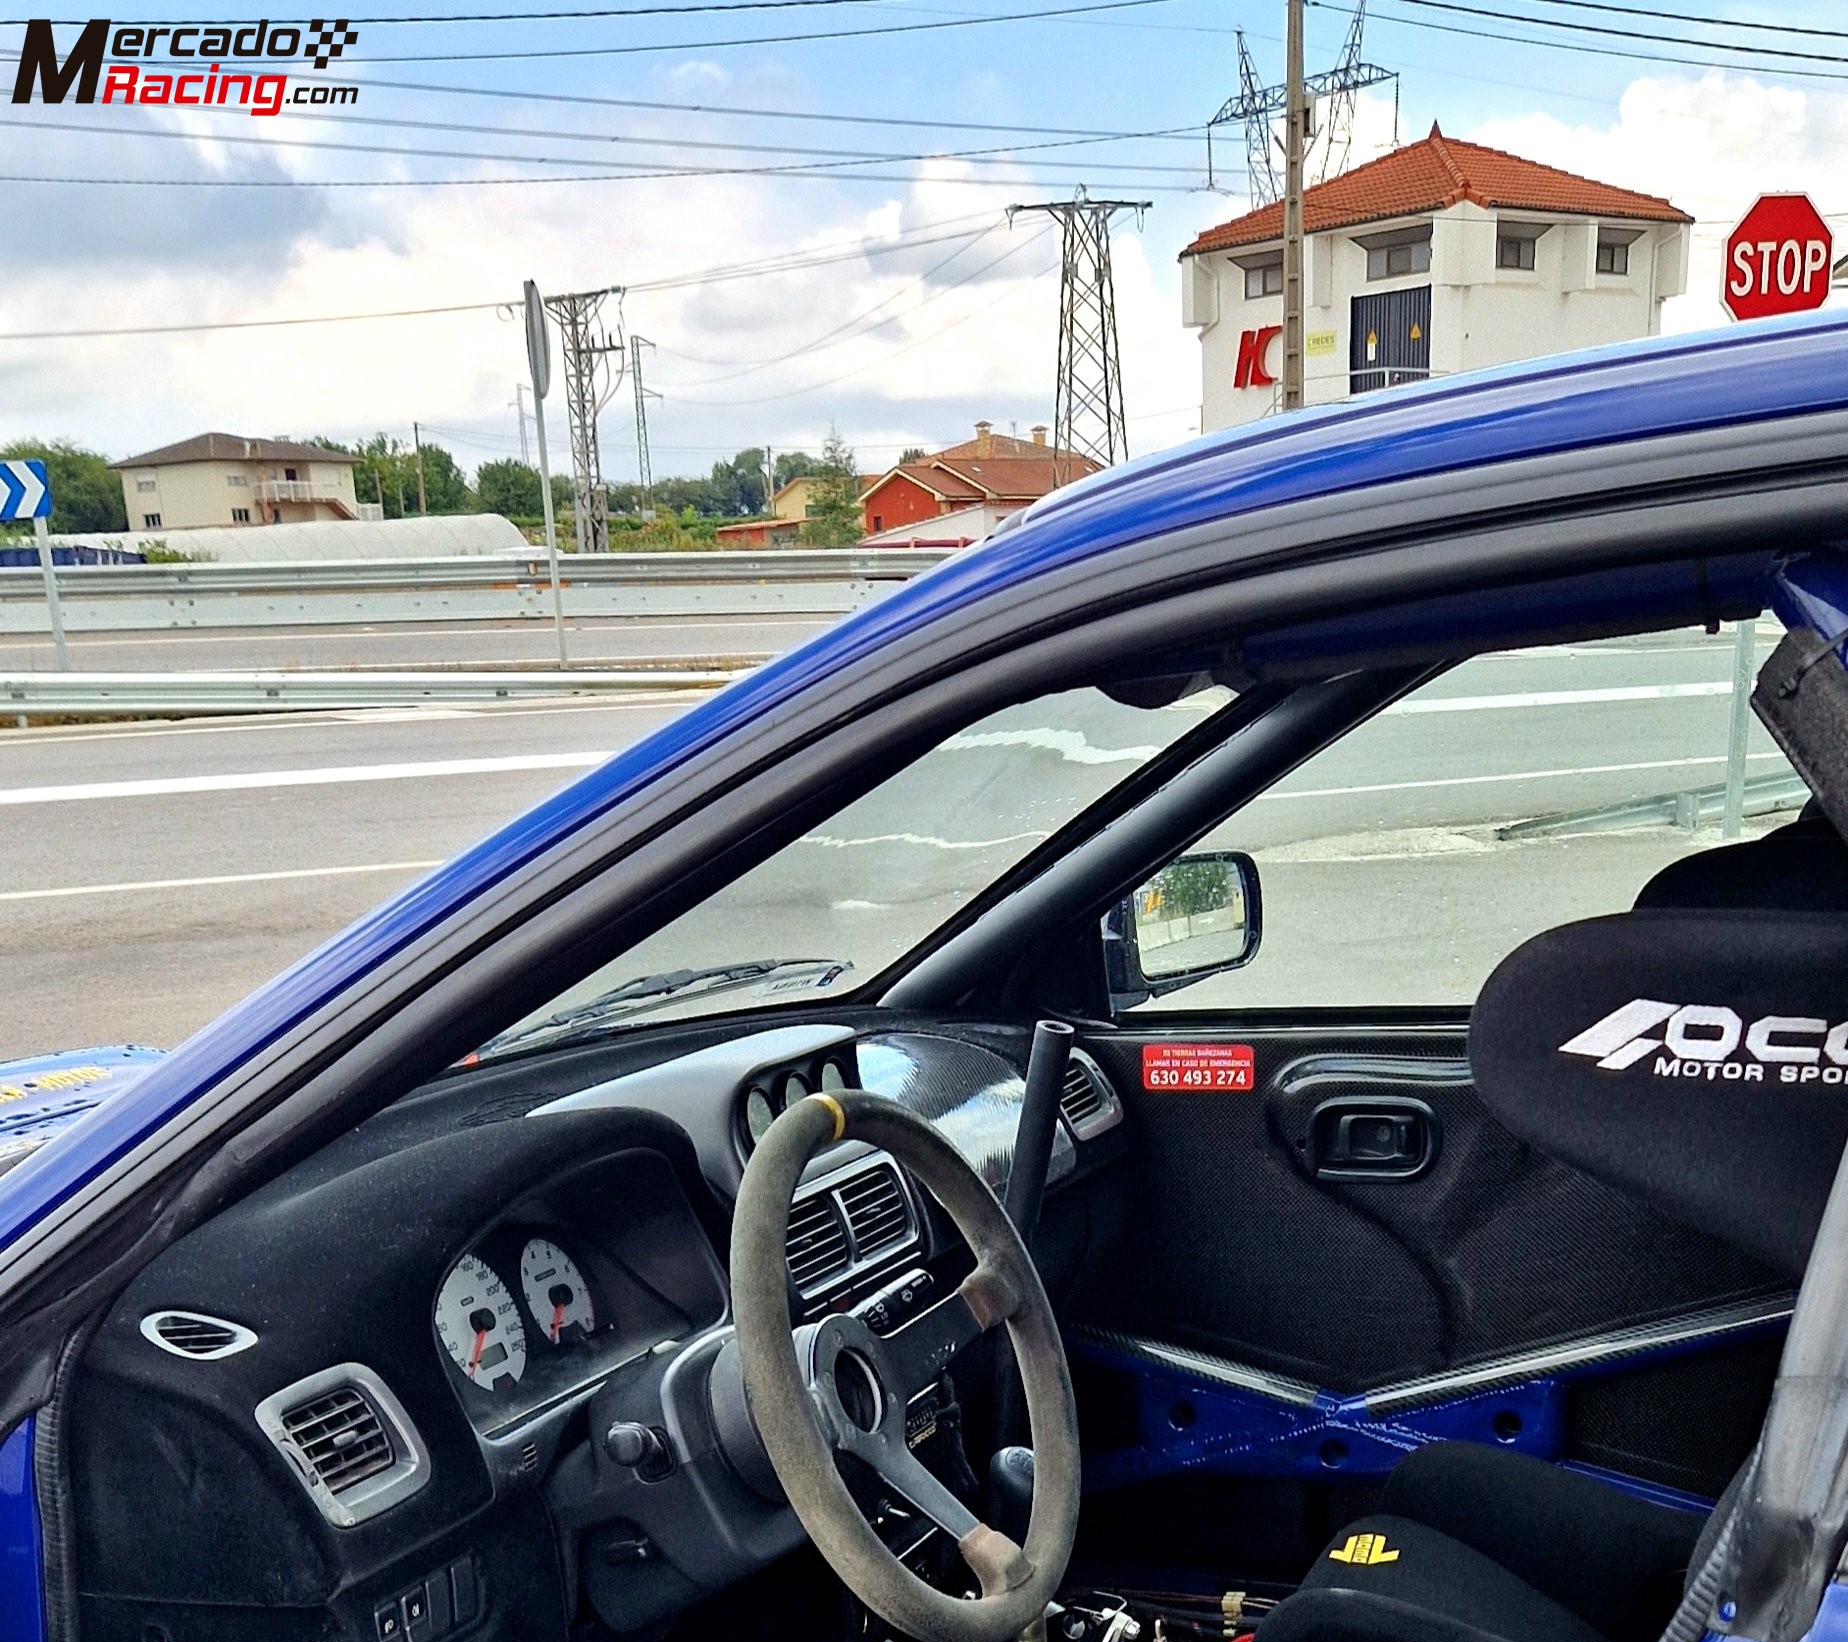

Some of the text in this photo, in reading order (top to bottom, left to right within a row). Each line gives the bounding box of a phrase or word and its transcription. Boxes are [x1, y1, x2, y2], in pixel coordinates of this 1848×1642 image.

[1730, 240, 1827, 297] STOP
[1654, 1057, 1764, 1082] MOTOR
[1150, 1070, 1246, 1085] 630 493 274
[486, 1284, 500, 1297] 200
[498, 1302, 511, 1315] 220
